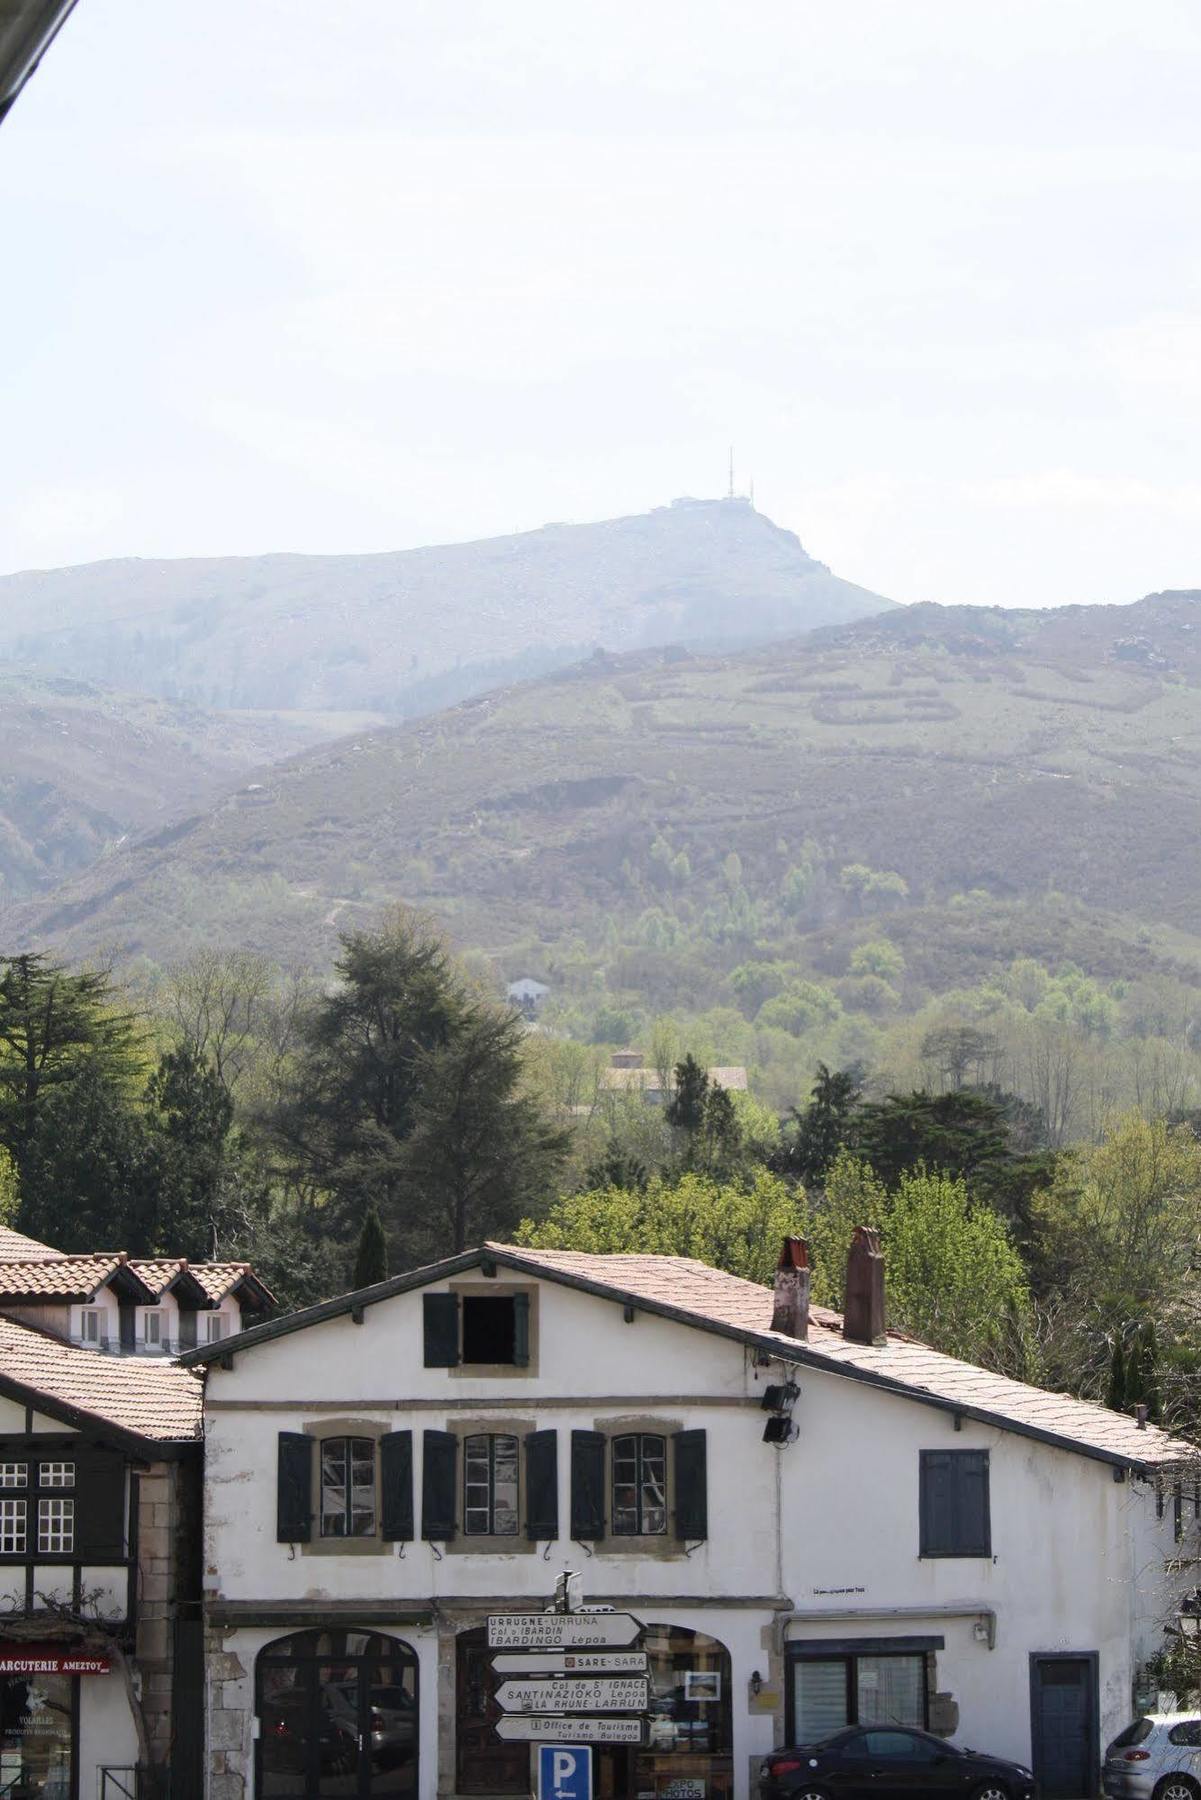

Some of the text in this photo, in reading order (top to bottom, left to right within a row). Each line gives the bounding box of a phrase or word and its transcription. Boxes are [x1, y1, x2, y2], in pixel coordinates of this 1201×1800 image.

[491, 1627, 507, 1635] Col
[491, 1636, 561, 1644] IBARDINGO
[62, 1661, 102, 1670] AMEZTOY
[609, 1681, 646, 1689] IGNACE
[507, 1690, 645, 1699] SANTINAZIOKO Lepoa
[535, 1700, 547, 1708] LA
[543, 1722, 639, 1731] Office de Tourisme
[553, 1752, 576, 1787] P
